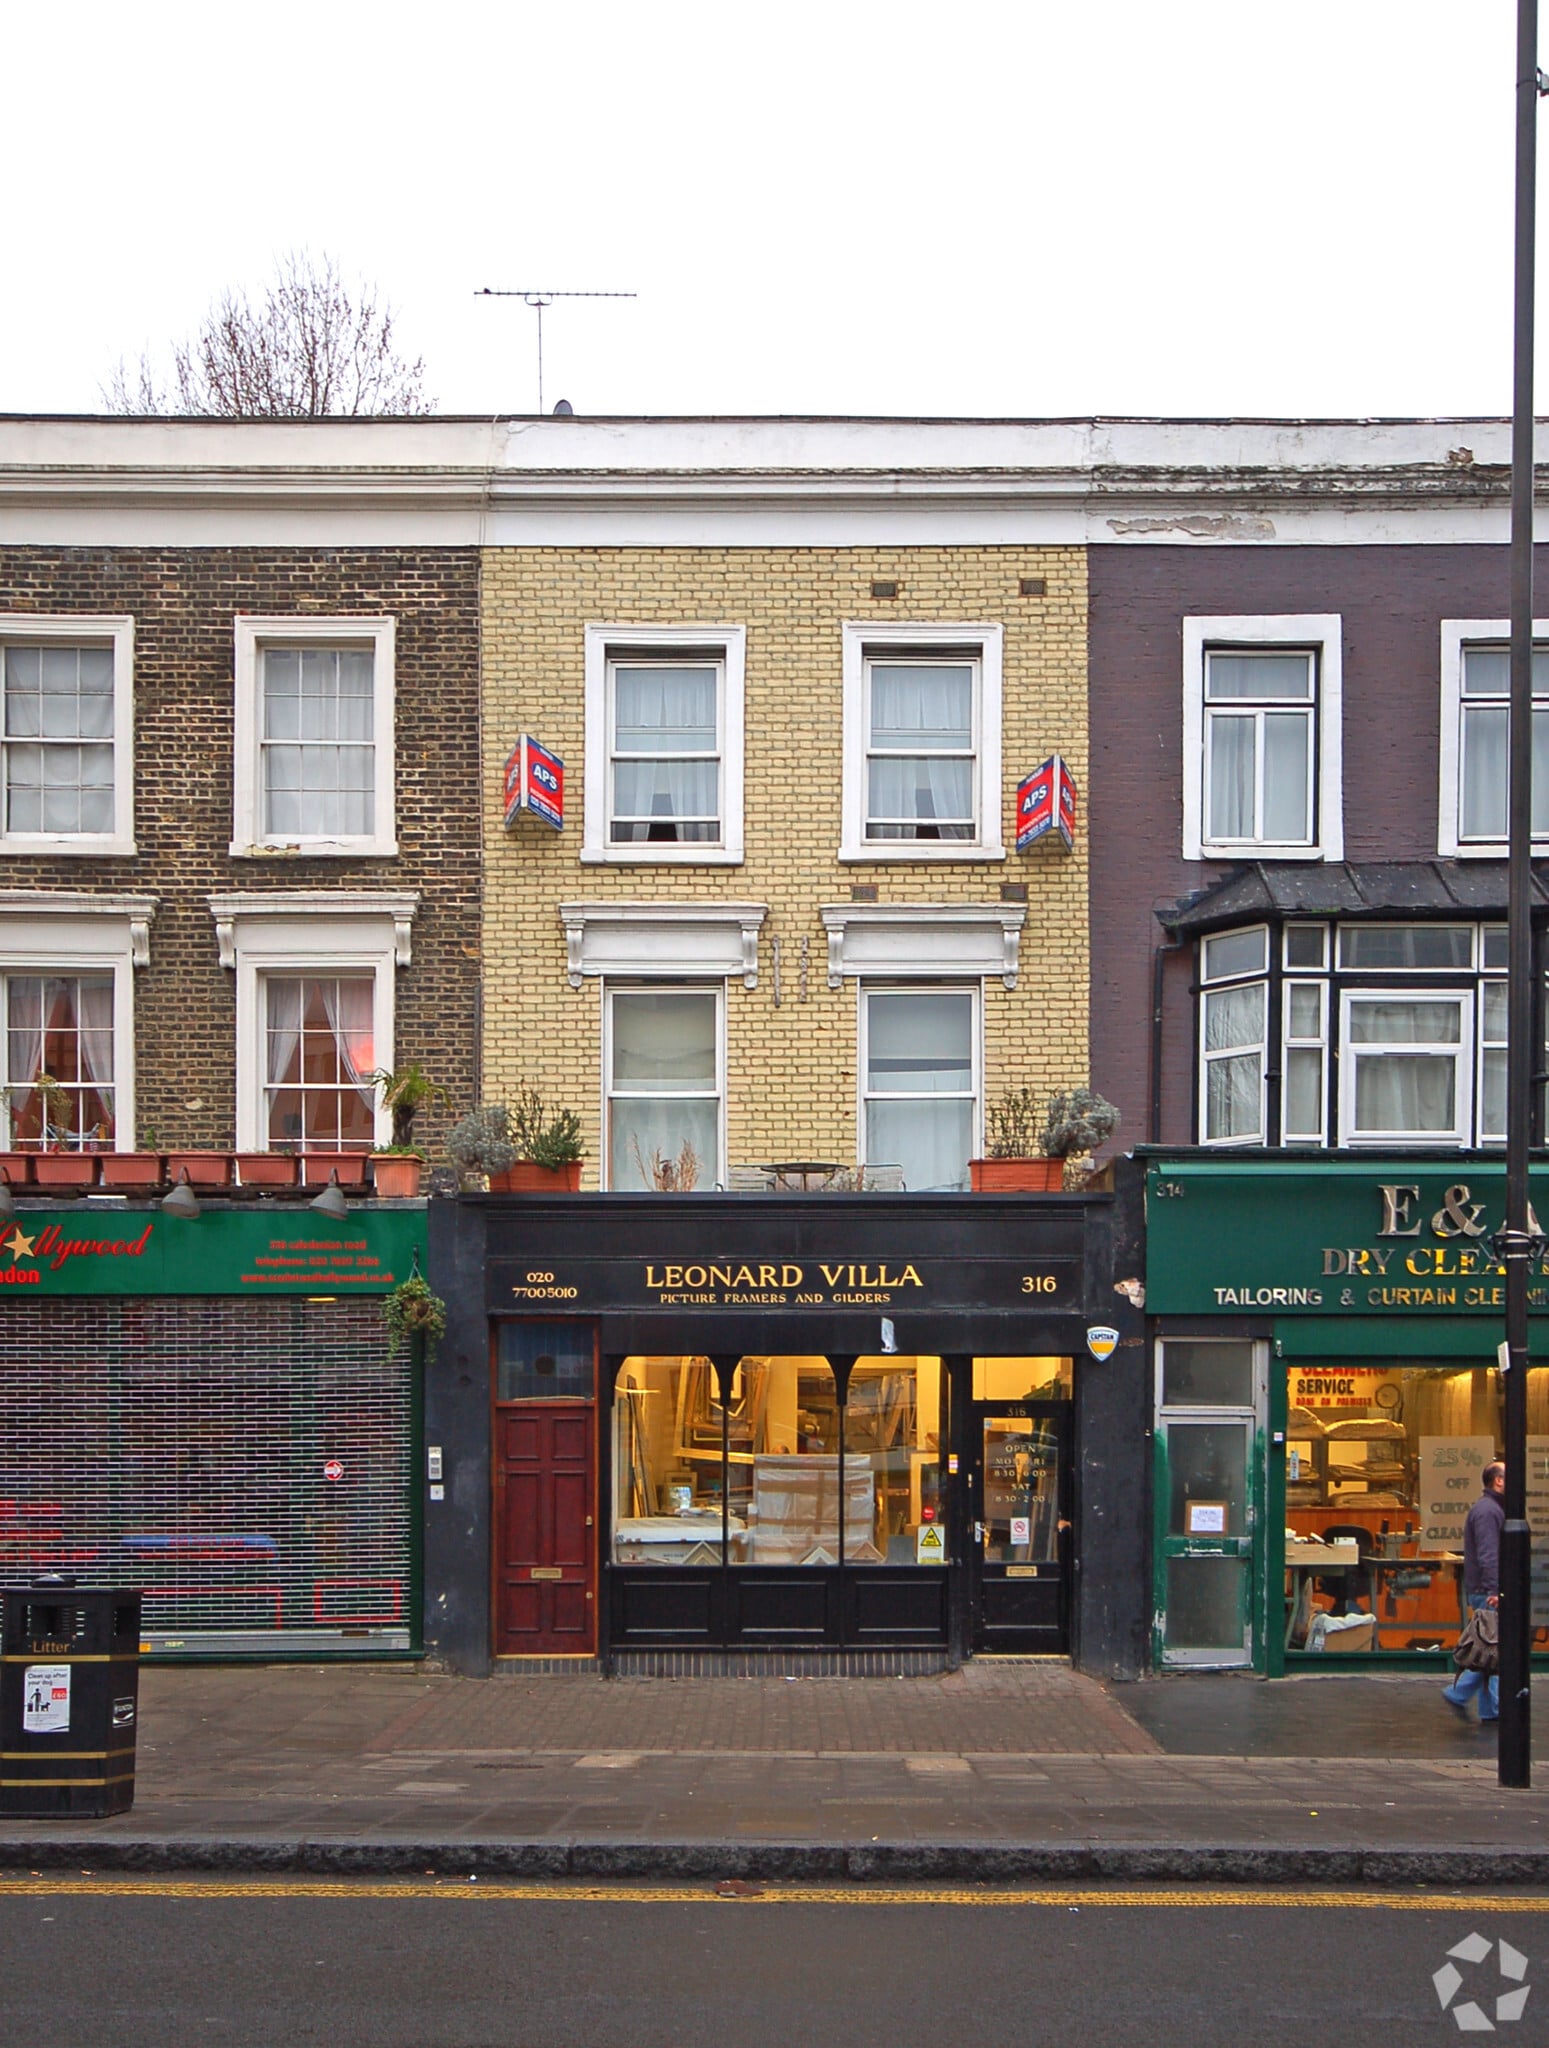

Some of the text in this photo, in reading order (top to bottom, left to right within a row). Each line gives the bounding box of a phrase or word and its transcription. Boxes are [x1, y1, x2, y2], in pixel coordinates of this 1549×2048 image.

[533, 765, 557, 790] APS
[1023, 785, 1047, 812] APS
[1156, 1182, 1184, 1197] 314
[1321, 1248, 1397, 1276] DRY
[526, 1272, 555, 1283] 020
[645, 1264, 924, 1288] LEONARD VILLA
[1021, 1276, 1057, 1293] 316
[660, 1292, 892, 1304] PICTURE FRAMERS AND GILDERS
[1213, 1287, 1323, 1306] TAILORING
[1340, 1288, 1355, 1305] &
[1367, 1287, 1457, 1305] CURTAIN
[1297, 1379, 1356, 1394] SERVICE
[1005, 1444, 1037, 1453] OPEN
[1433, 1447, 1483, 1468] 25%
[1446, 1477, 1470, 1489] OFF
[33, 1641, 70, 1653] Litter
